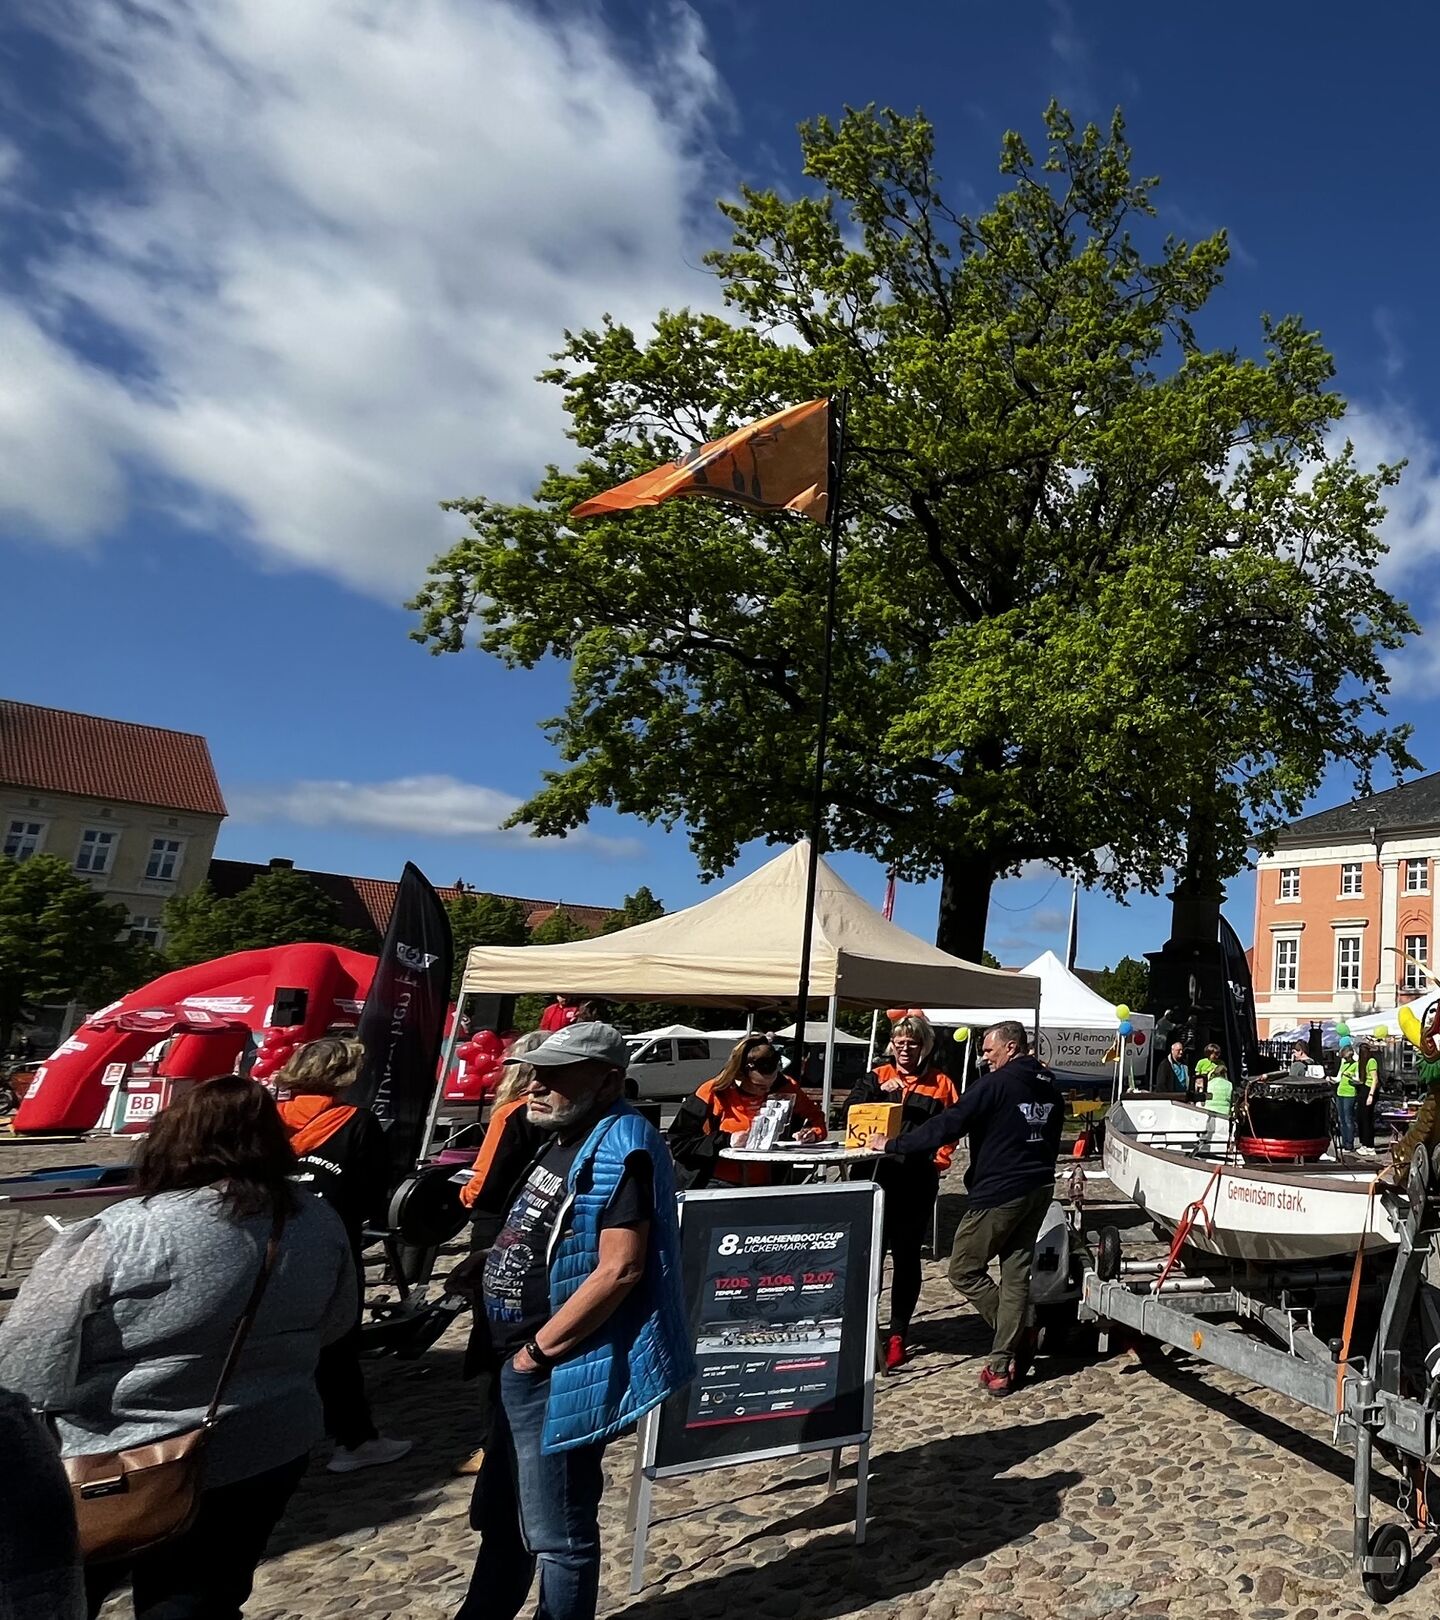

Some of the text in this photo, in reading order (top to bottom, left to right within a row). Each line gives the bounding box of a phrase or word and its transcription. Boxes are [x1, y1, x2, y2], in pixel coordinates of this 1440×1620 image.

[1057, 1032, 1070, 1041] SV
[1057, 1046, 1081, 1056] 1952
[130, 1096, 154, 1110] BB
[1228, 1180, 1307, 1213] Gemeinsam stark.
[718, 1233, 744, 1256] 8.
[744, 1232, 844, 1245] DRACHENBOOT-CUP
[744, 1240, 838, 1254] UCKERMARK 2025
